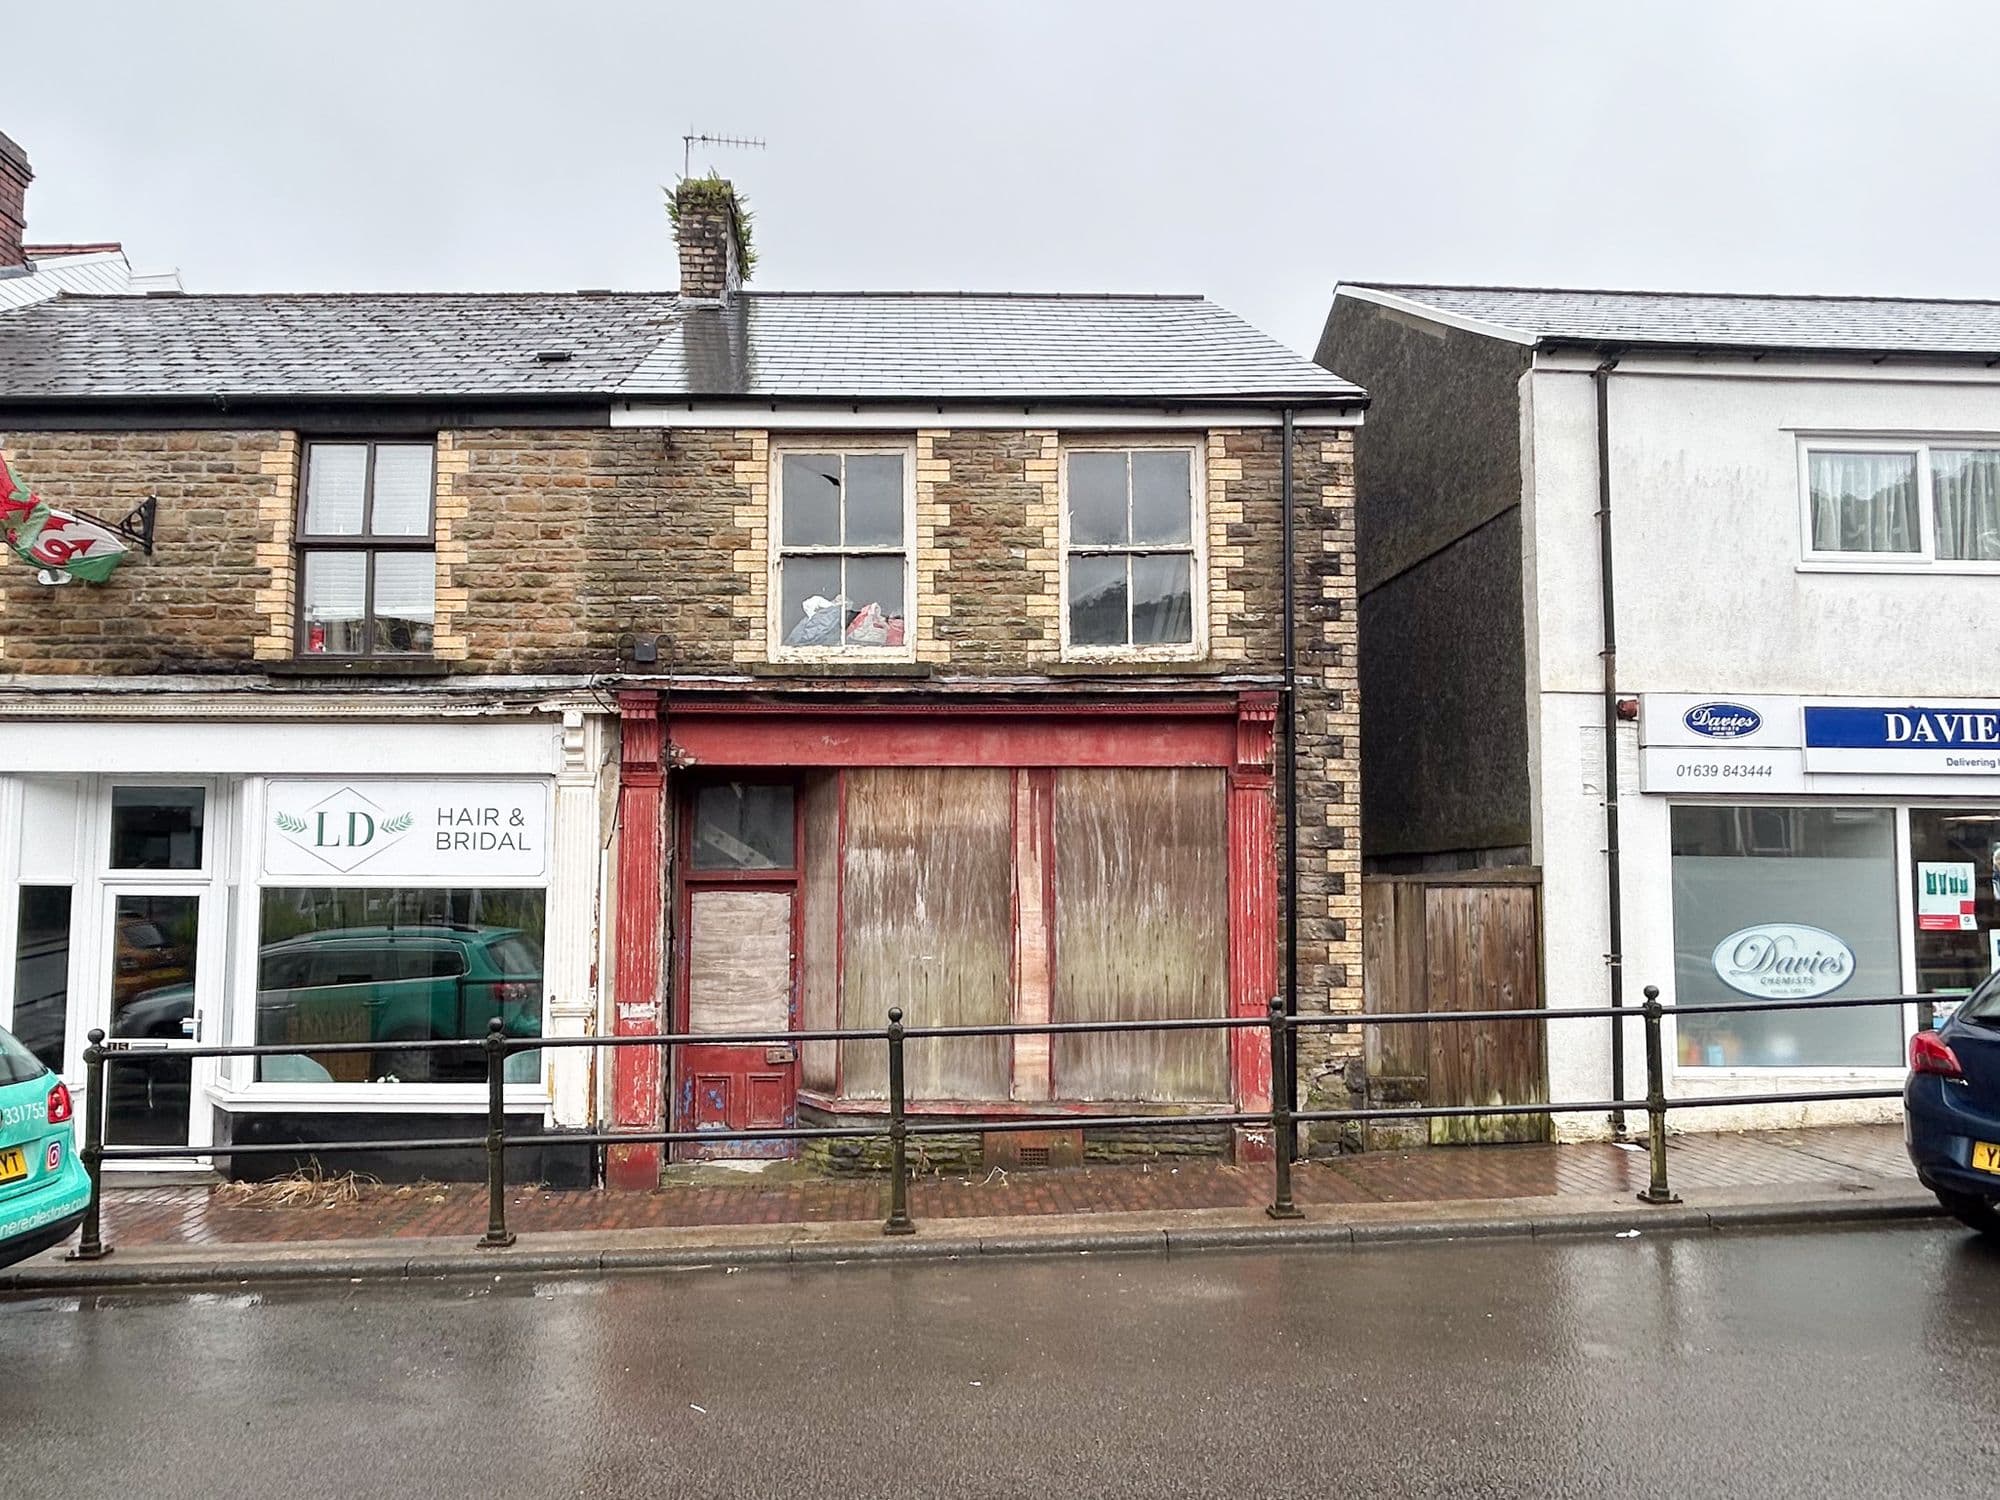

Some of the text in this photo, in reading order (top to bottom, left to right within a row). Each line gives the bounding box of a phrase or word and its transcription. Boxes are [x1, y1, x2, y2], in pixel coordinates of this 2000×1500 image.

[1691, 707, 1758, 728] Davies
[1884, 713, 2000, 743] DAVIE
[1676, 764, 1773, 777] 01639 843444
[1946, 757, 1996, 769] Delivering
[437, 808, 525, 827] HAIR &
[314, 811, 375, 848] LD
[436, 832, 532, 851] BRIDAL
[1729, 934, 1845, 976] Davies
[1760, 976, 1815, 986] CHEMISTS
[3, 1102, 46, 1126] 331755
[0, 1151, 19, 1175] YT
[1986, 1146, 2000, 1168] Y
[0, 1197, 89, 1237] nerealestate.co
